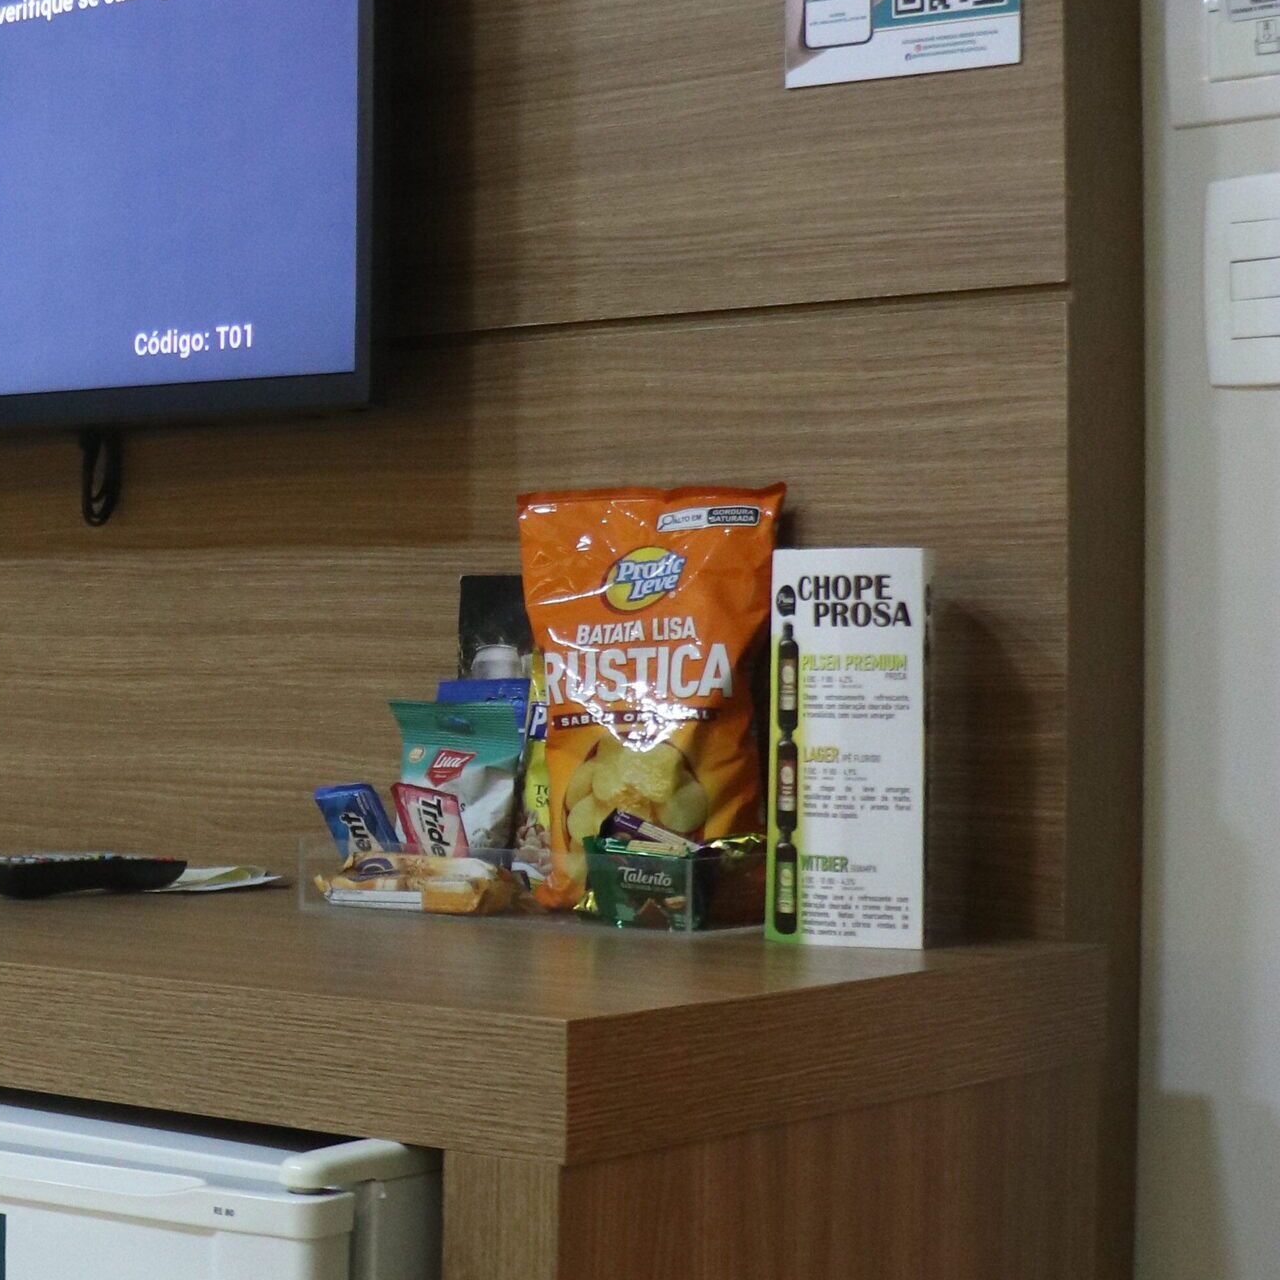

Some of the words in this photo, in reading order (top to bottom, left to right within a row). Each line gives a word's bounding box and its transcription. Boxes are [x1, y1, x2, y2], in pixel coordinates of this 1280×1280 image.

[134, 328, 209, 358] Código:
[215, 323, 252, 349] T01
[797, 574, 893, 601] CHOPE
[813, 601, 912, 627] PROSA
[575, 619, 645, 645] BATATA
[652, 616, 696, 641] LISA
[845, 654, 907, 671] PREMIUM
[617, 866, 673, 887] Talento
